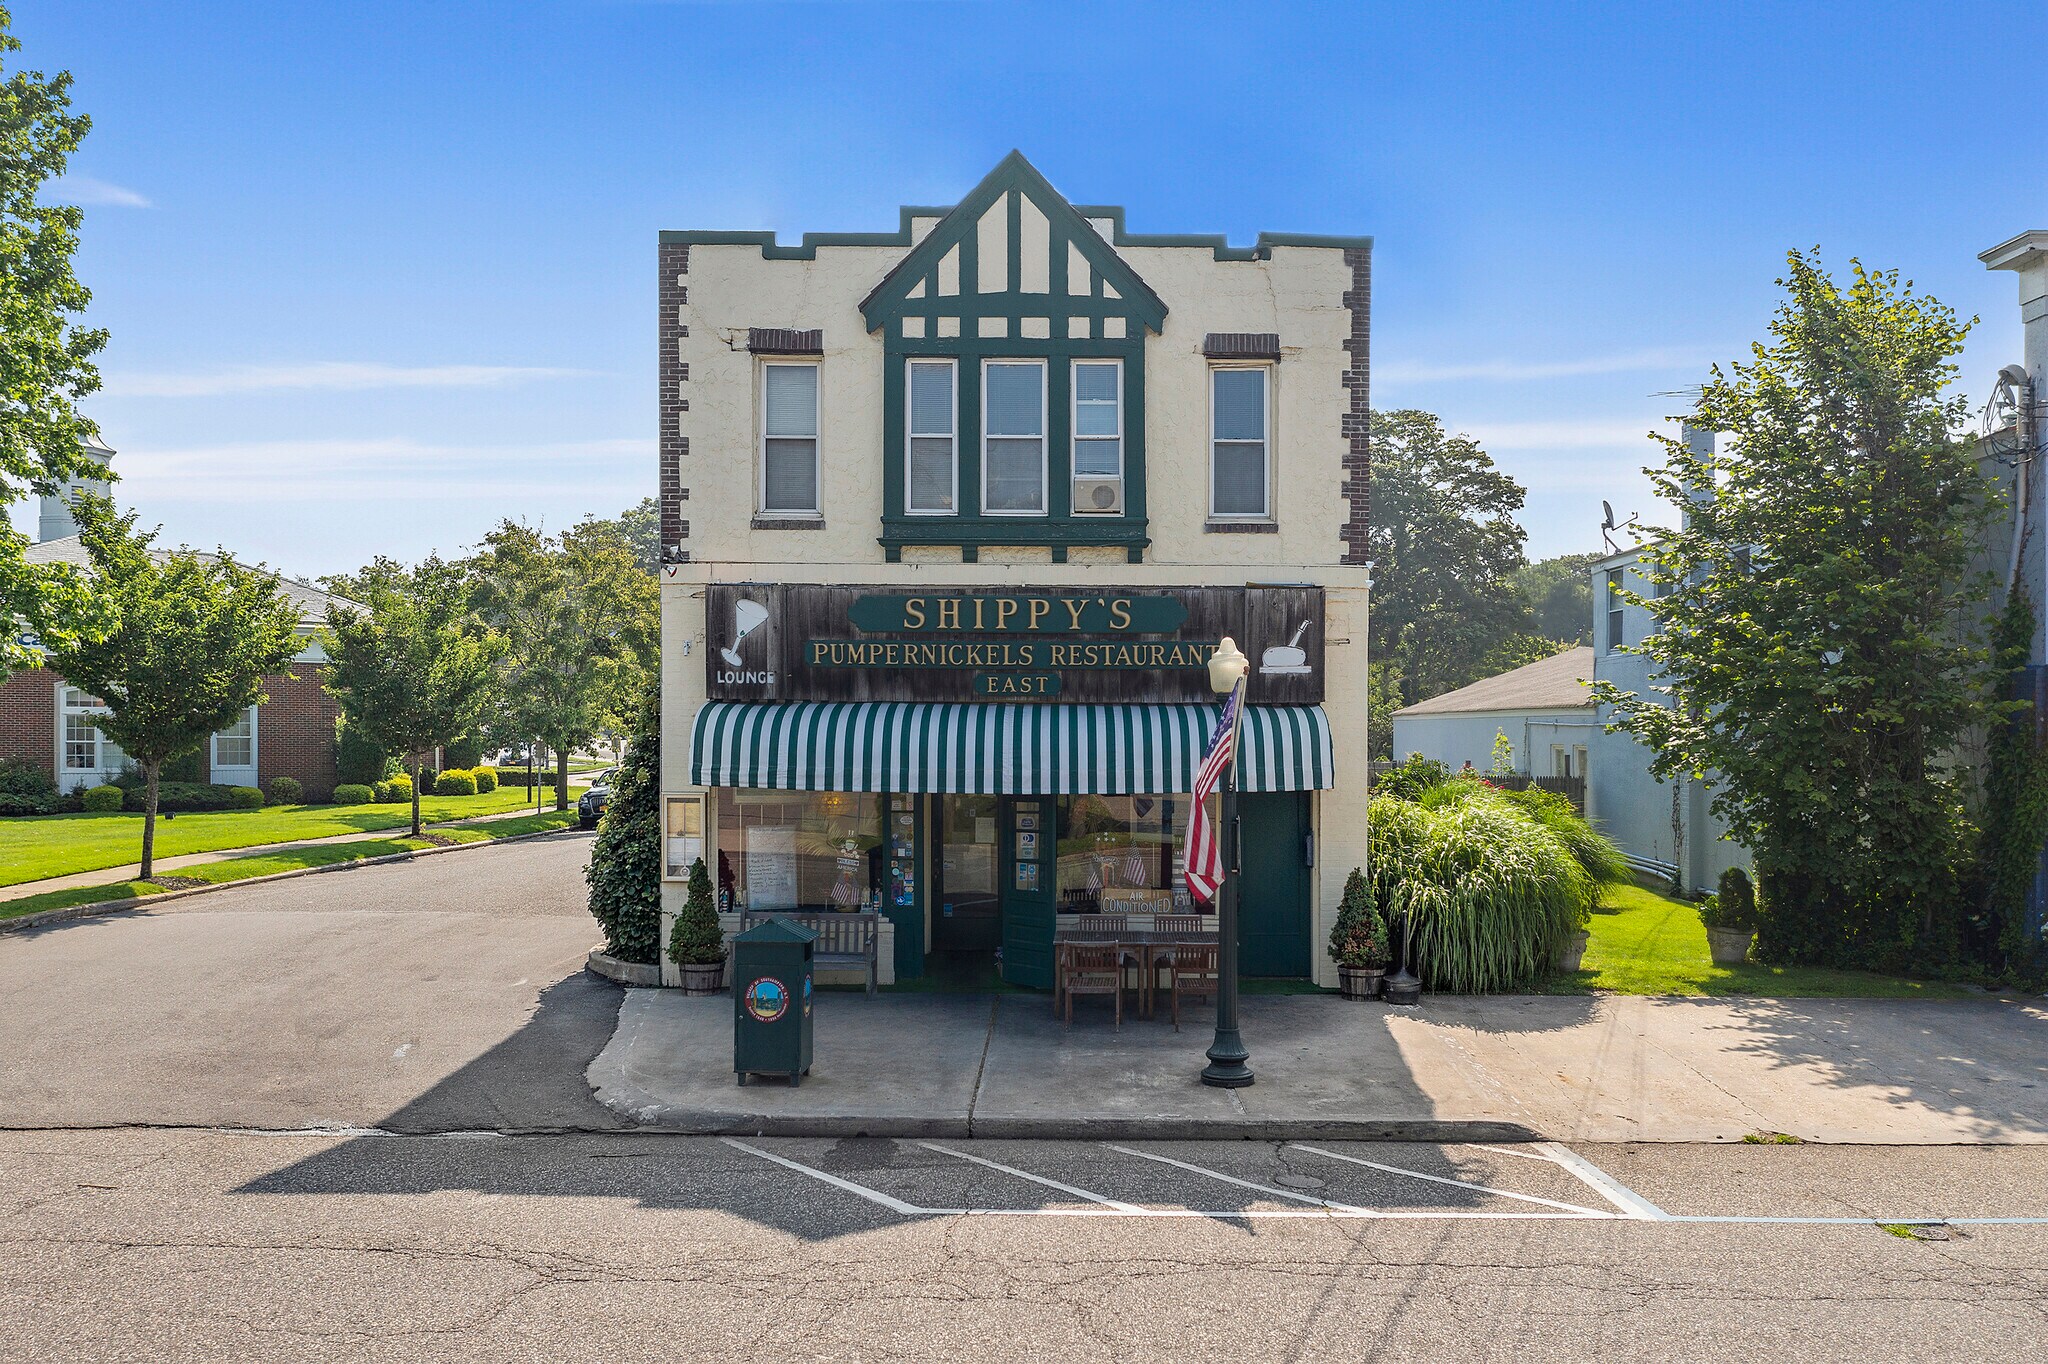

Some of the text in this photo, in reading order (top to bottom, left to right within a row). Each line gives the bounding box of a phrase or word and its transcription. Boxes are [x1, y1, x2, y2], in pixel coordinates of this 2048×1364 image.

[903, 598, 1131, 630] SHIPPY'S
[813, 643, 1034, 666] PUMPERNICKELS
[717, 670, 775, 684] LOUNGE
[987, 676, 1049, 694] EAST
[1129, 891, 1144, 901] AIR
[1102, 897, 1171, 913] CONDITIONED
